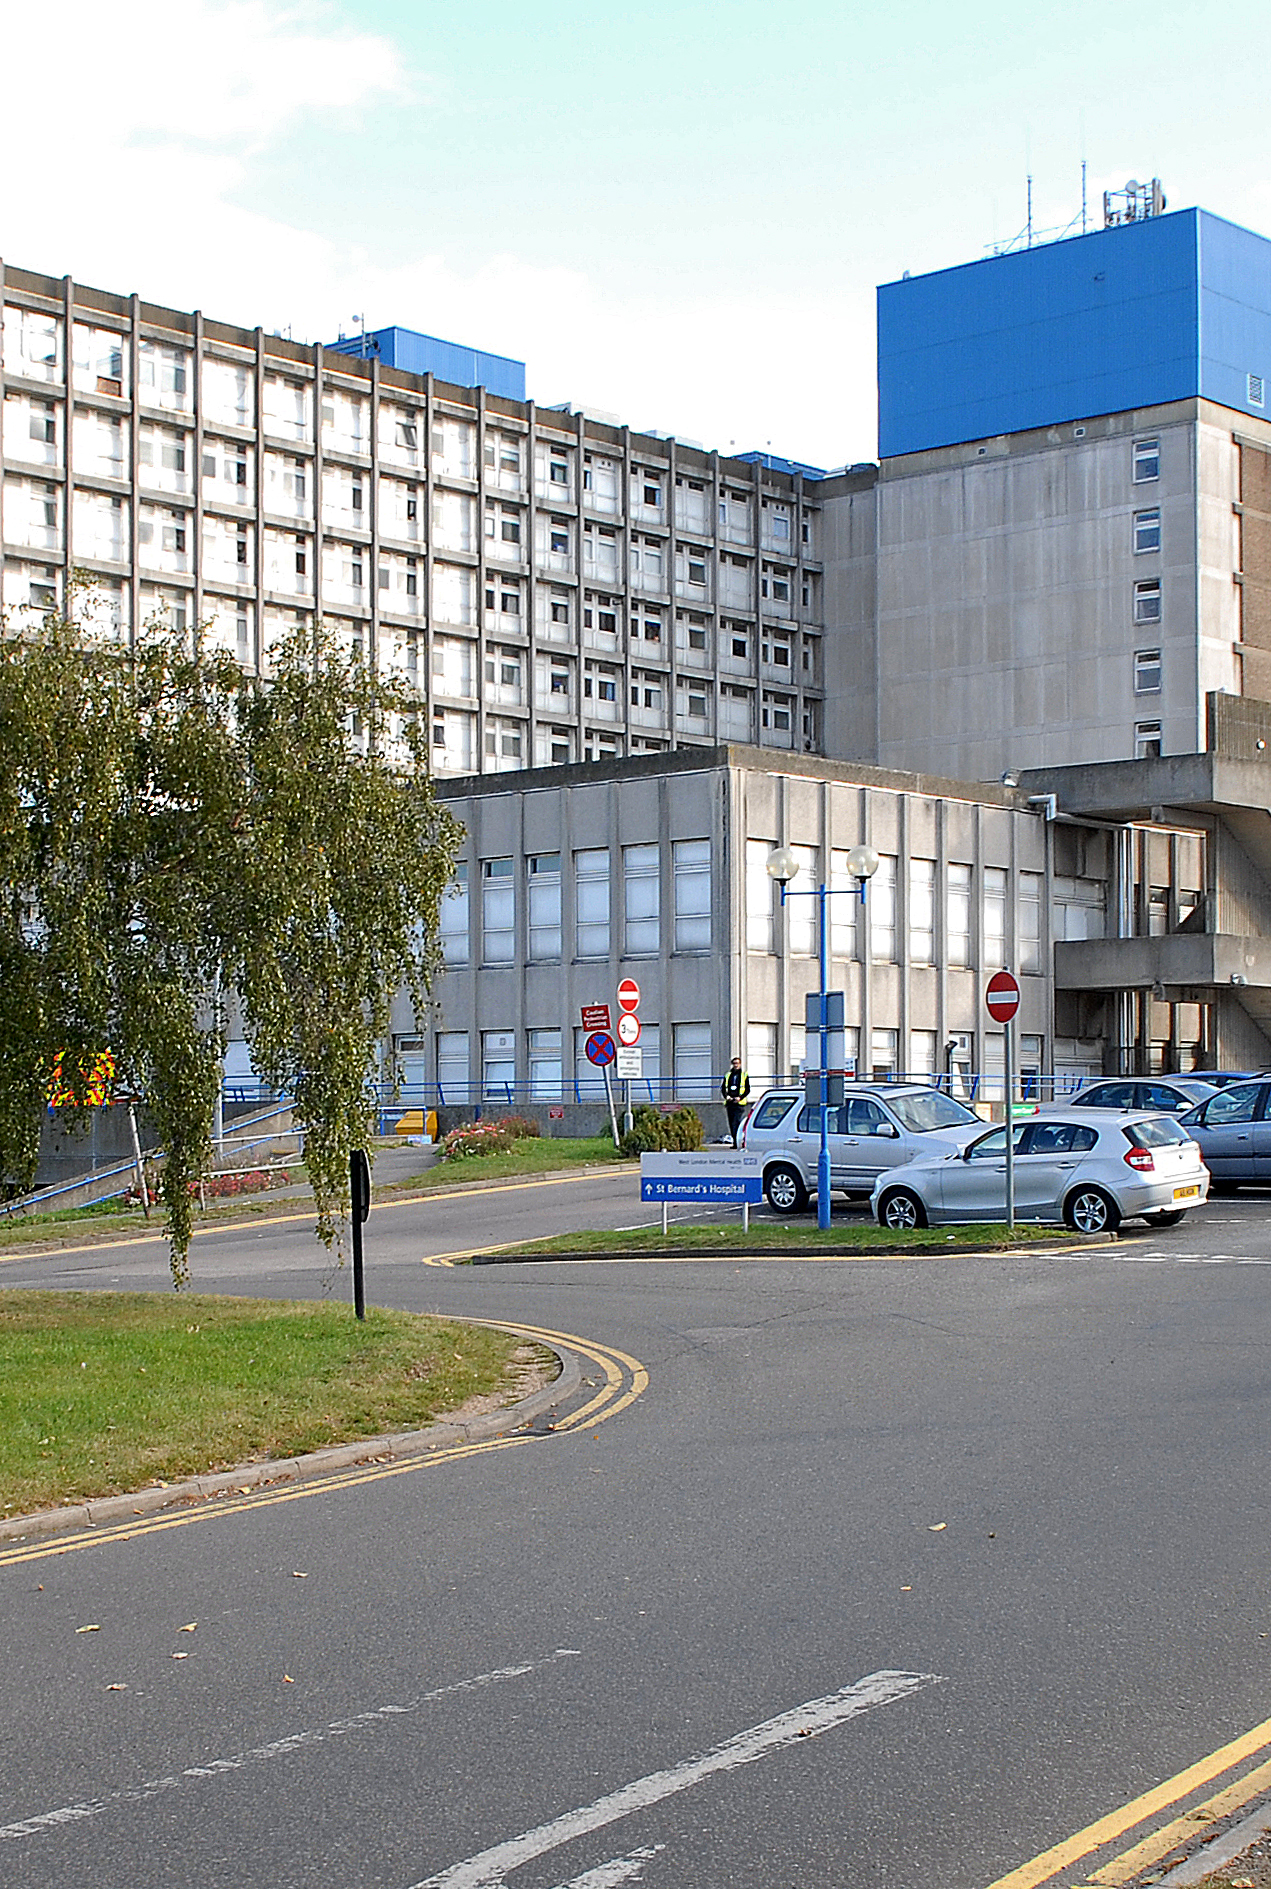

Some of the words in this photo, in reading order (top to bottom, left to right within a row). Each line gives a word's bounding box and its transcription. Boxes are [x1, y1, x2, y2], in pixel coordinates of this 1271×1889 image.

[621, 1024, 626, 1034] 3
[656, 1184, 665, 1193] St
[668, 1184, 707, 1194] Bernard's
[709, 1183, 745, 1195] Hospital
